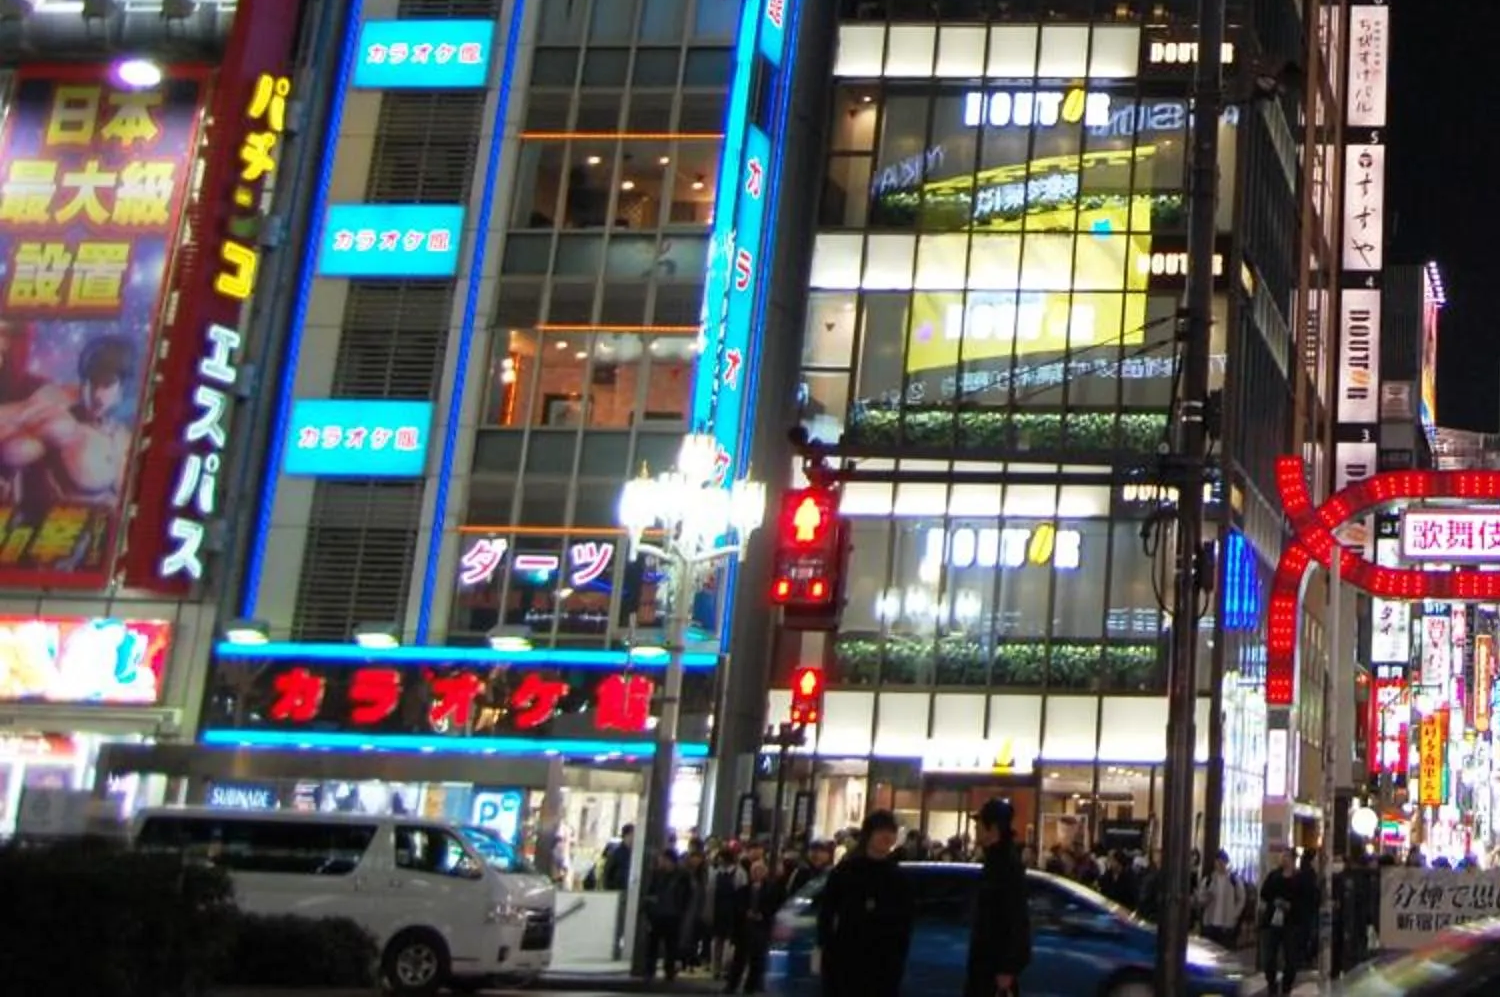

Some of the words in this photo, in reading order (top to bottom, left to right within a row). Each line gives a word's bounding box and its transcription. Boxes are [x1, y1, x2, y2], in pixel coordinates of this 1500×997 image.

[366, 43, 482, 64] カラオケ館
[1151, 43, 1234, 64] DOUTR
[46, 86, 163, 146] 日本
[3, 159, 175, 226] 最大級
[333, 230, 452, 252] カラオケ館
[8, 243, 130, 307] 設置
[1137, 253, 1223, 276] DOUTR
[1365, 275, 1375, 288] 4
[298, 427, 422, 450] カラオケ館
[161, 323, 241, 580] エスパス
[461, 538, 612, 586] ダーツ
